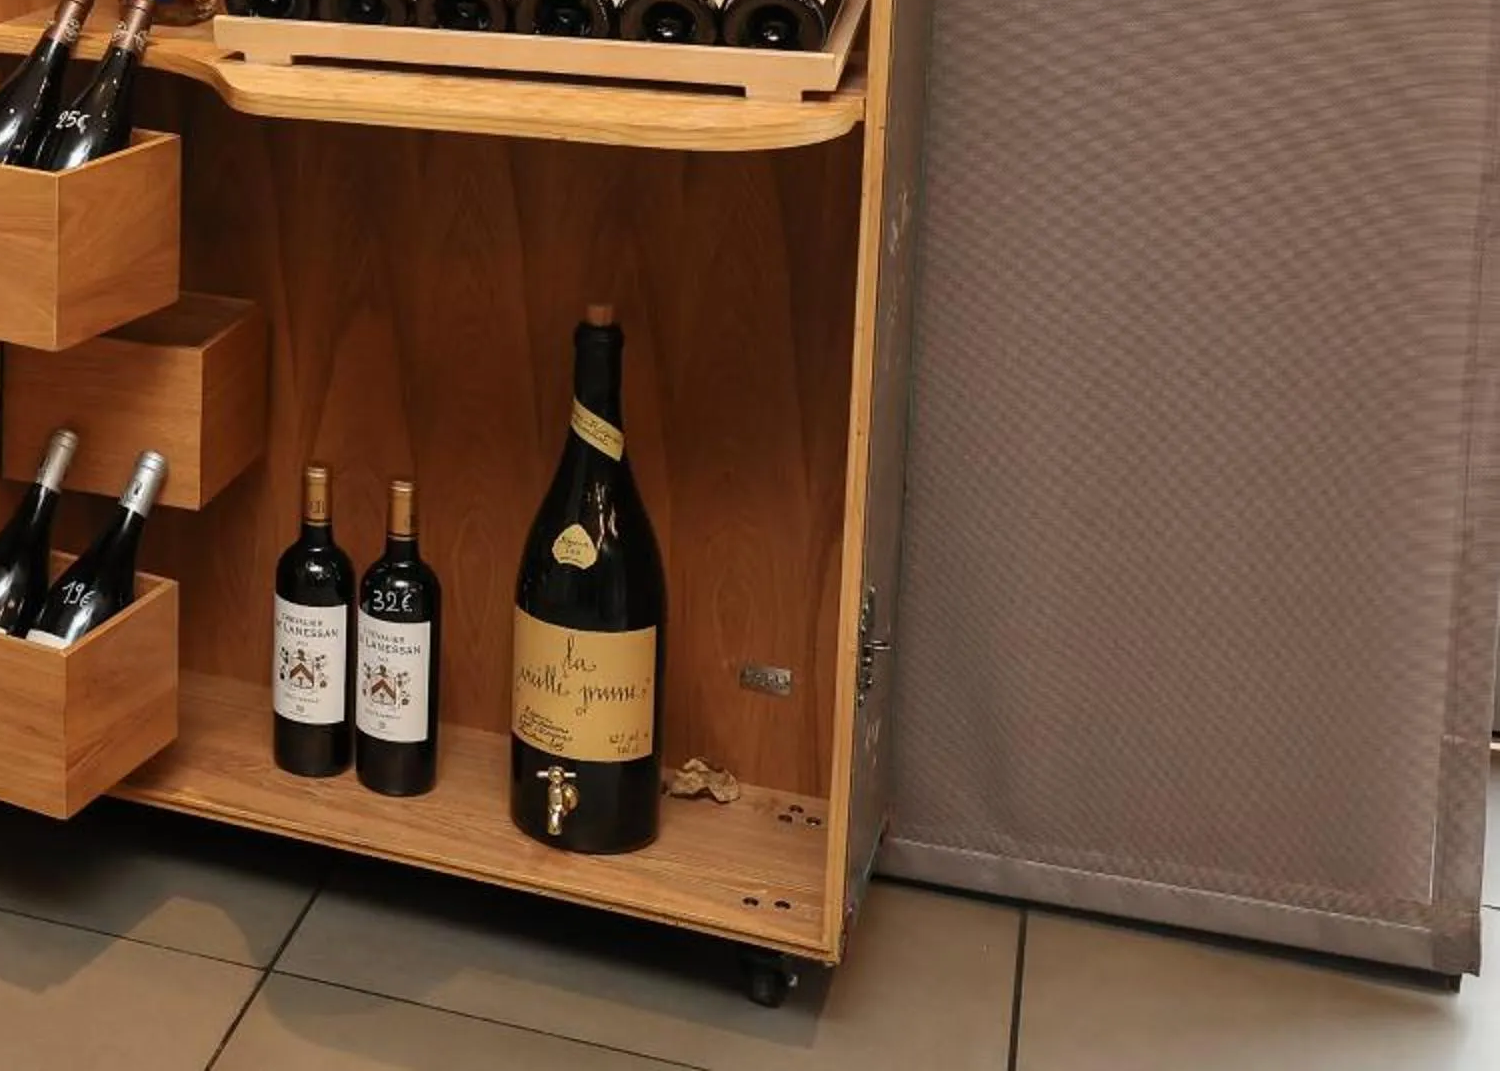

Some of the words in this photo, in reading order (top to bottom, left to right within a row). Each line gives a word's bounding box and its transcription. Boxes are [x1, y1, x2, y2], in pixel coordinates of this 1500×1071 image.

[62, 580, 95, 608] 19€
[372, 589, 413, 612] 32€
[283, 623, 339, 639] LANESSAN
[365, 637, 421, 655] LANESSAN
